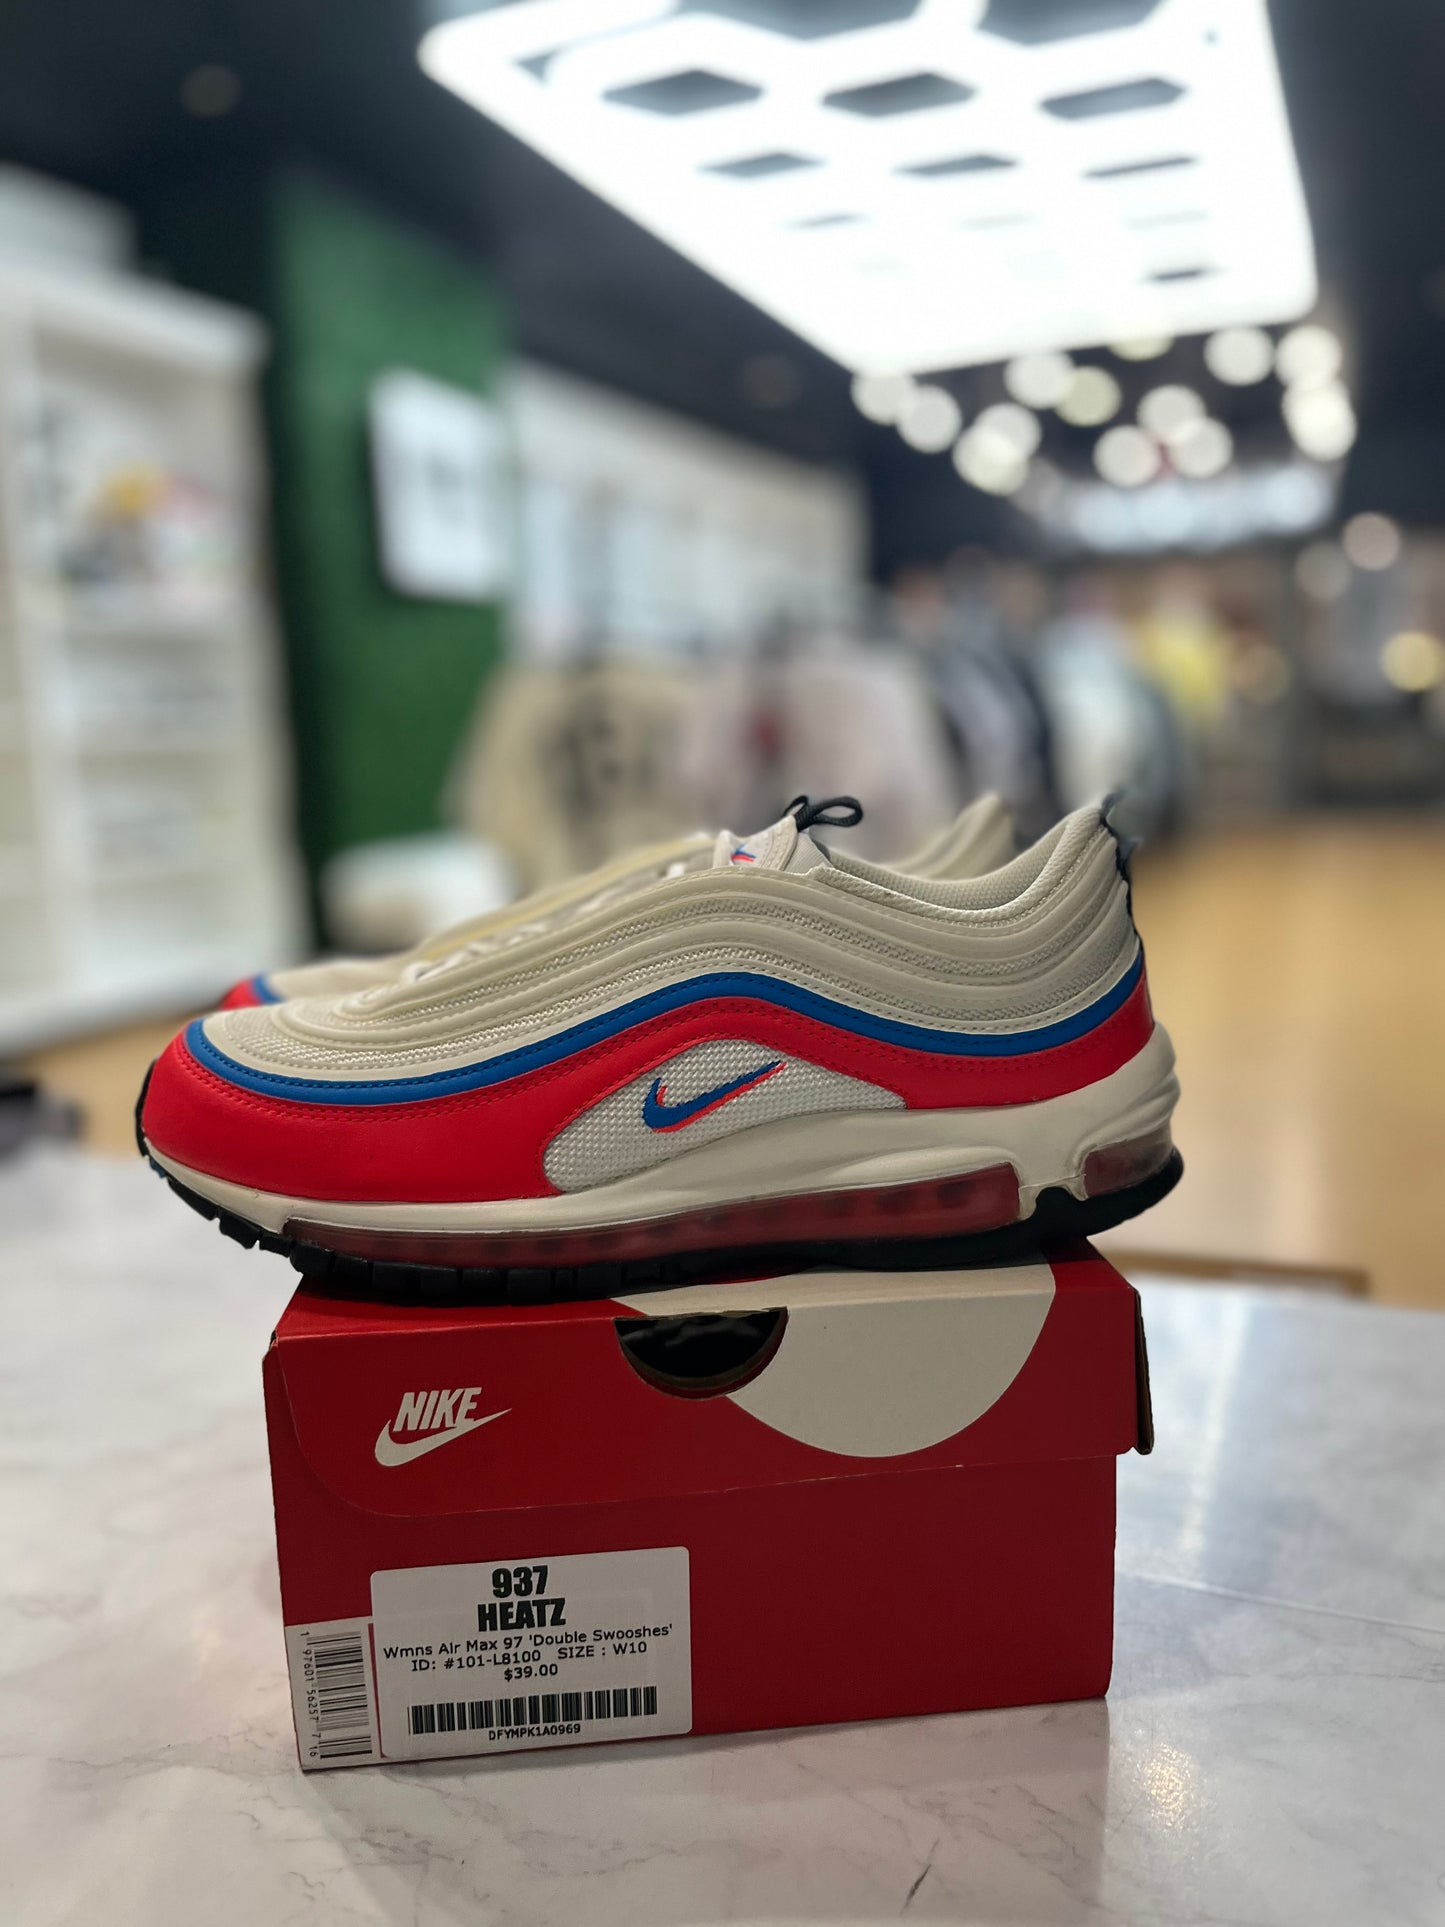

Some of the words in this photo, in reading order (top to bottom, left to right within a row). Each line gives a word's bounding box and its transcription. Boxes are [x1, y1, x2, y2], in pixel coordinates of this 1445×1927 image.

[392, 1386, 482, 1432] NIKE
[491, 1565, 548, 1598] 937
[477, 1597, 566, 1632] HEATZ
[383, 1645, 433, 1659] Wmns
[466, 1639, 498, 1652] Max
[503, 1636, 523, 1649] 97
[529, 1631, 587, 1646] 'Double
[593, 1623, 673, 1641] Swooshes'
[411, 1659, 436, 1672] ID:
[444, 1649, 541, 1669] #101-L8100
[557, 1645, 595, 1660] SIZE
[612, 1641, 647, 1655] W10
[302, 1650, 315, 1682] 97601
[504, 1663, 558, 1682] $39.00
[306, 1689, 319, 1722] 56257
[488, 1723, 581, 1741] DFYMPK1A0969
